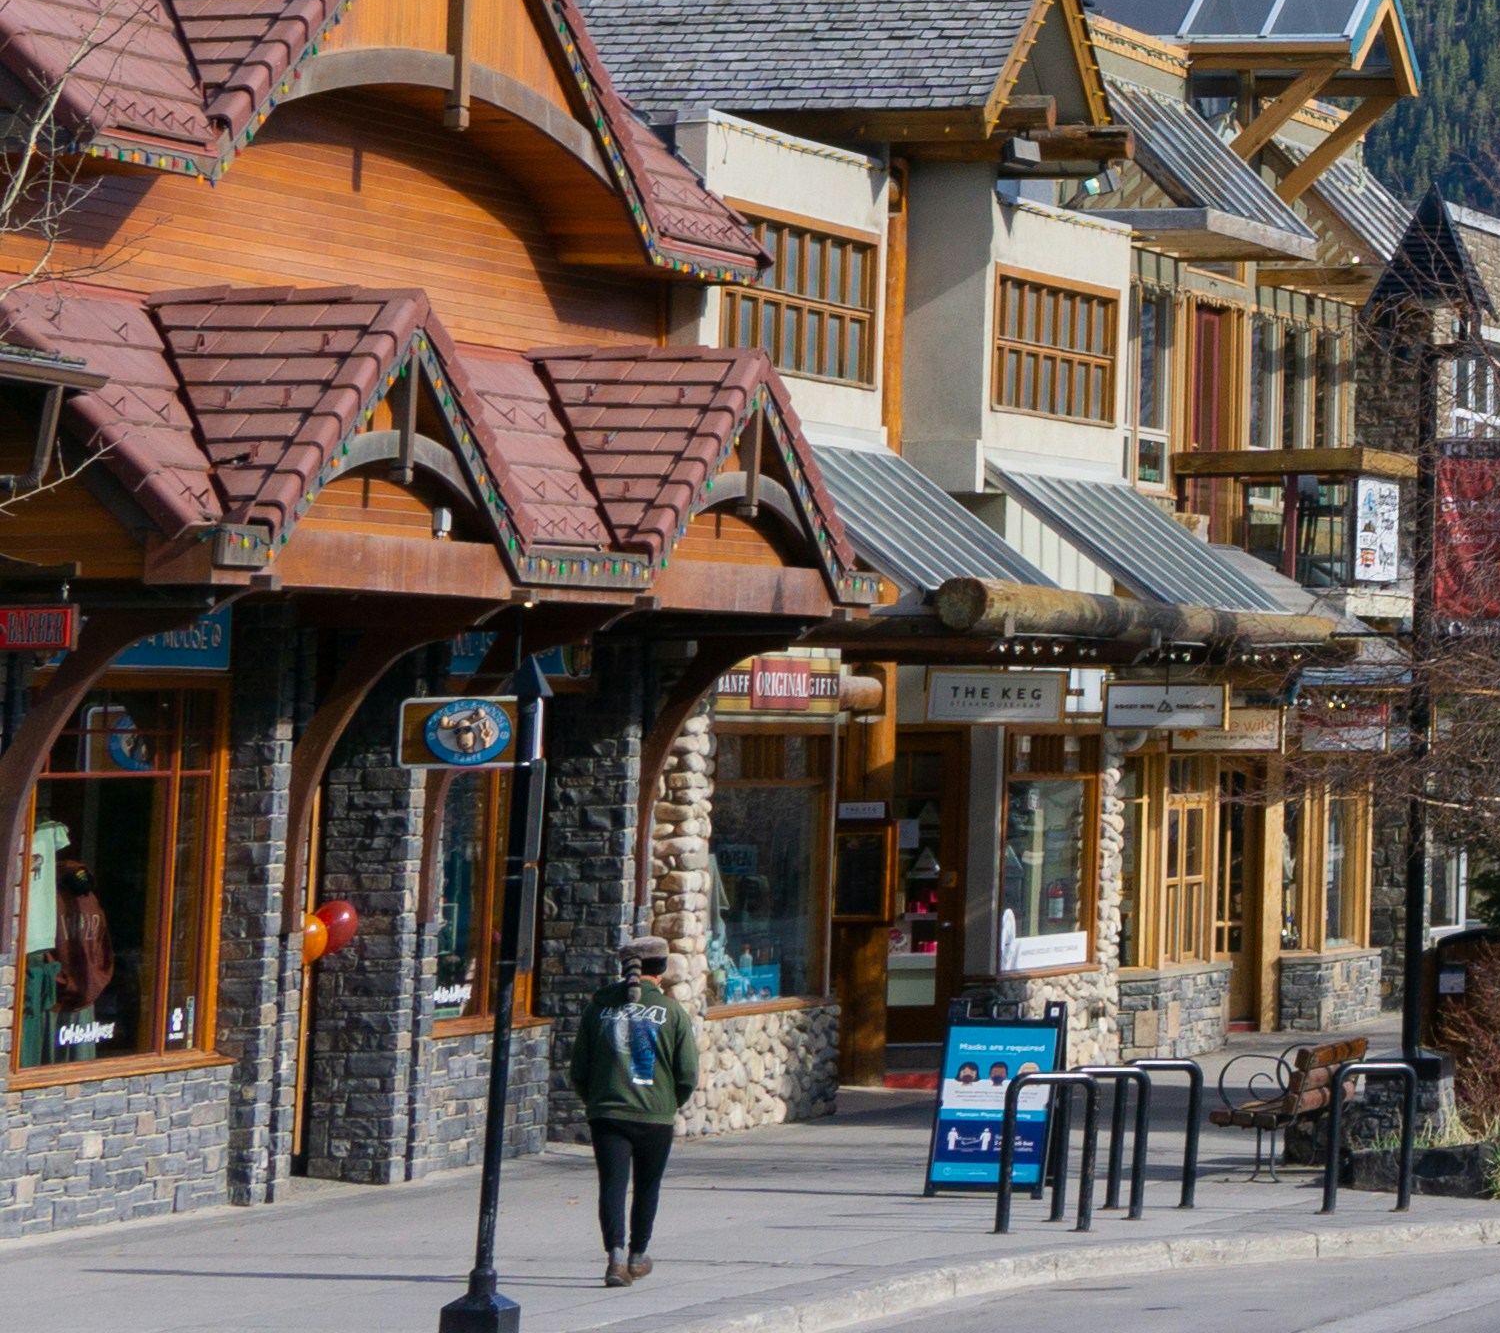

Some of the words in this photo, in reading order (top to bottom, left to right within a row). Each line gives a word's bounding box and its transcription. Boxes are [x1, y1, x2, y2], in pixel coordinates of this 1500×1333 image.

[6, 612, 65, 644] BARBER
[718, 674, 750, 693] BANFF
[756, 672, 808, 698] ORIGINAL
[808, 677, 838, 695] GIFTS
[950, 686, 990, 700] THE
[1001, 687, 1043, 700] KEG
[1245, 719, 1276, 733] wild
[959, 1043, 987, 1051] Masks
[1005, 1044, 1046, 1053] required
